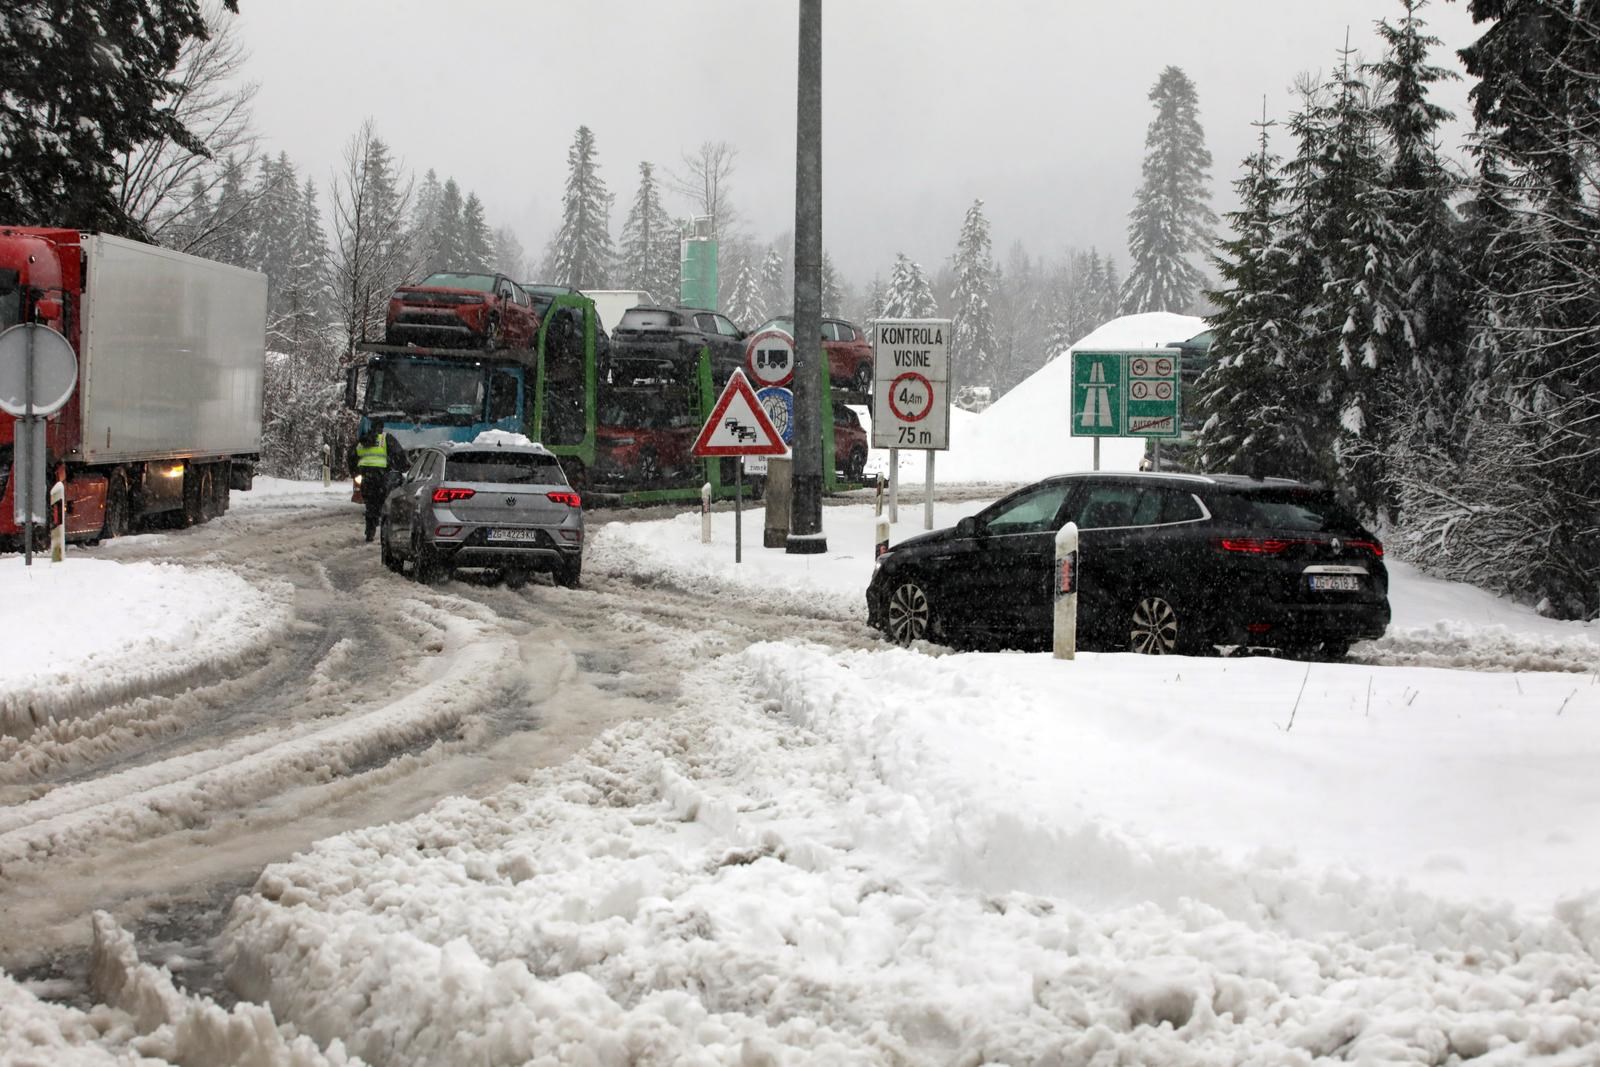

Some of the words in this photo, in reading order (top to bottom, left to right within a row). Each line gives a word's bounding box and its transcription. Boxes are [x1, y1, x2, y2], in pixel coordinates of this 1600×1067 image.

[881, 327, 943, 345] KONTROLA
[893, 350, 931, 367] VISINE
[898, 426, 916, 444] 75
[919, 431, 931, 444] m
